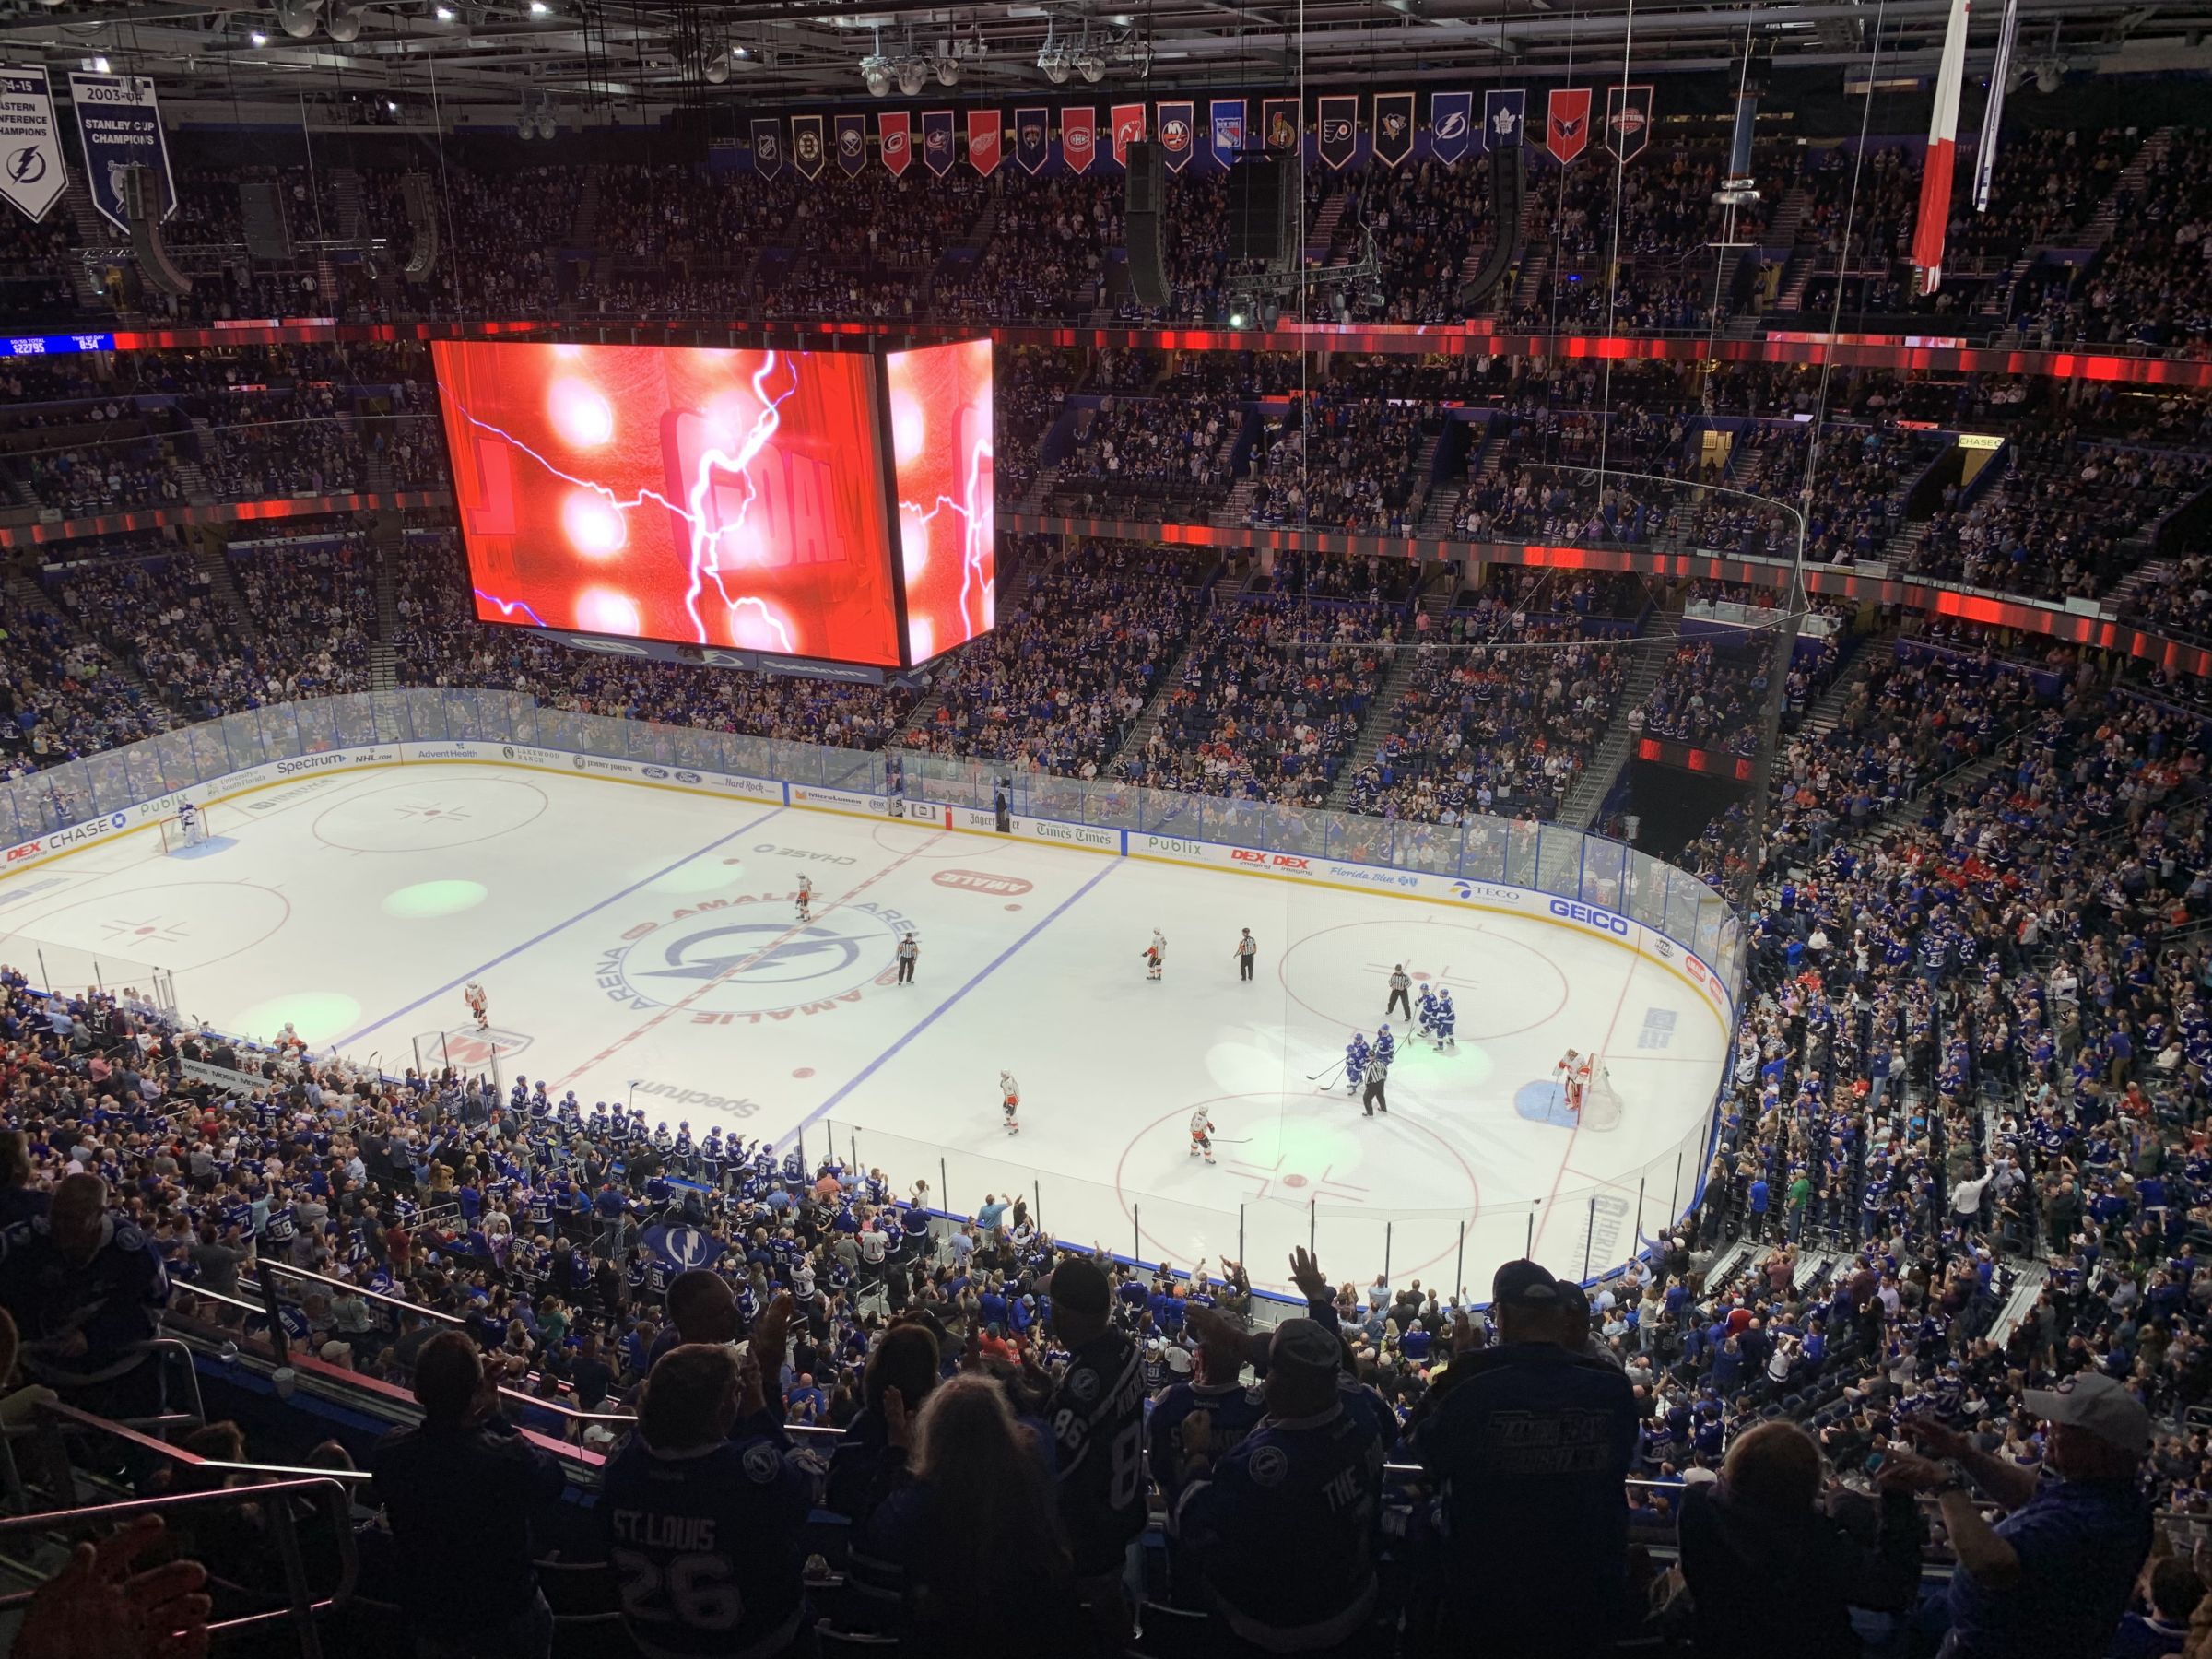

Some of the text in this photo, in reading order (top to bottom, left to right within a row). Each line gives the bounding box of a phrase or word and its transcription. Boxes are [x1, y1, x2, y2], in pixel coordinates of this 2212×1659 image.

[0, 102, 36, 112] ASTERN
[0, 115, 47, 124] NFERENCE
[86, 119, 155, 131] STANLEY CUP
[0, 127, 46, 136] HAMPIONS
[92, 134, 154, 145] CHAMPIONS
[1959, 437, 1993, 447] CHASE
[517, 747, 559, 759] LAKEWOOD
[277, 754, 342, 774] Spectrum
[587, 759, 609, 770] JIMMY
[644, 767, 666, 780] Ford
[677, 772, 700, 784] Ford
[725, 777, 764, 794] Hard Rock
[140, 793, 189, 816] Publix
[49, 818, 110, 850] CHASE
[1036, 822, 1072, 841] Times
[1076, 828, 1111, 845] Times
[7, 841, 42, 863] DEX
[1148, 836, 1202, 857] Publix
[774, 847, 857, 865] CHASE
[1231, 849, 1310, 870] DEX DEX
[936, 872, 1027, 892] AMALIE
[1330, 866, 1395, 884] Florida Blue
[1475, 886, 1520, 900] TECO
[1549, 898, 1629, 937] GEICO
[595, 945, 862, 1025] AMALIE ARENA
[632, 1078, 760, 1119] Spectrum
[534, 1207, 547, 1220] 91
[652, 1274, 665, 1289] 91
[613, 1508, 717, 1551] ST.LOUIS
[612, 1548, 745, 1630] 26
